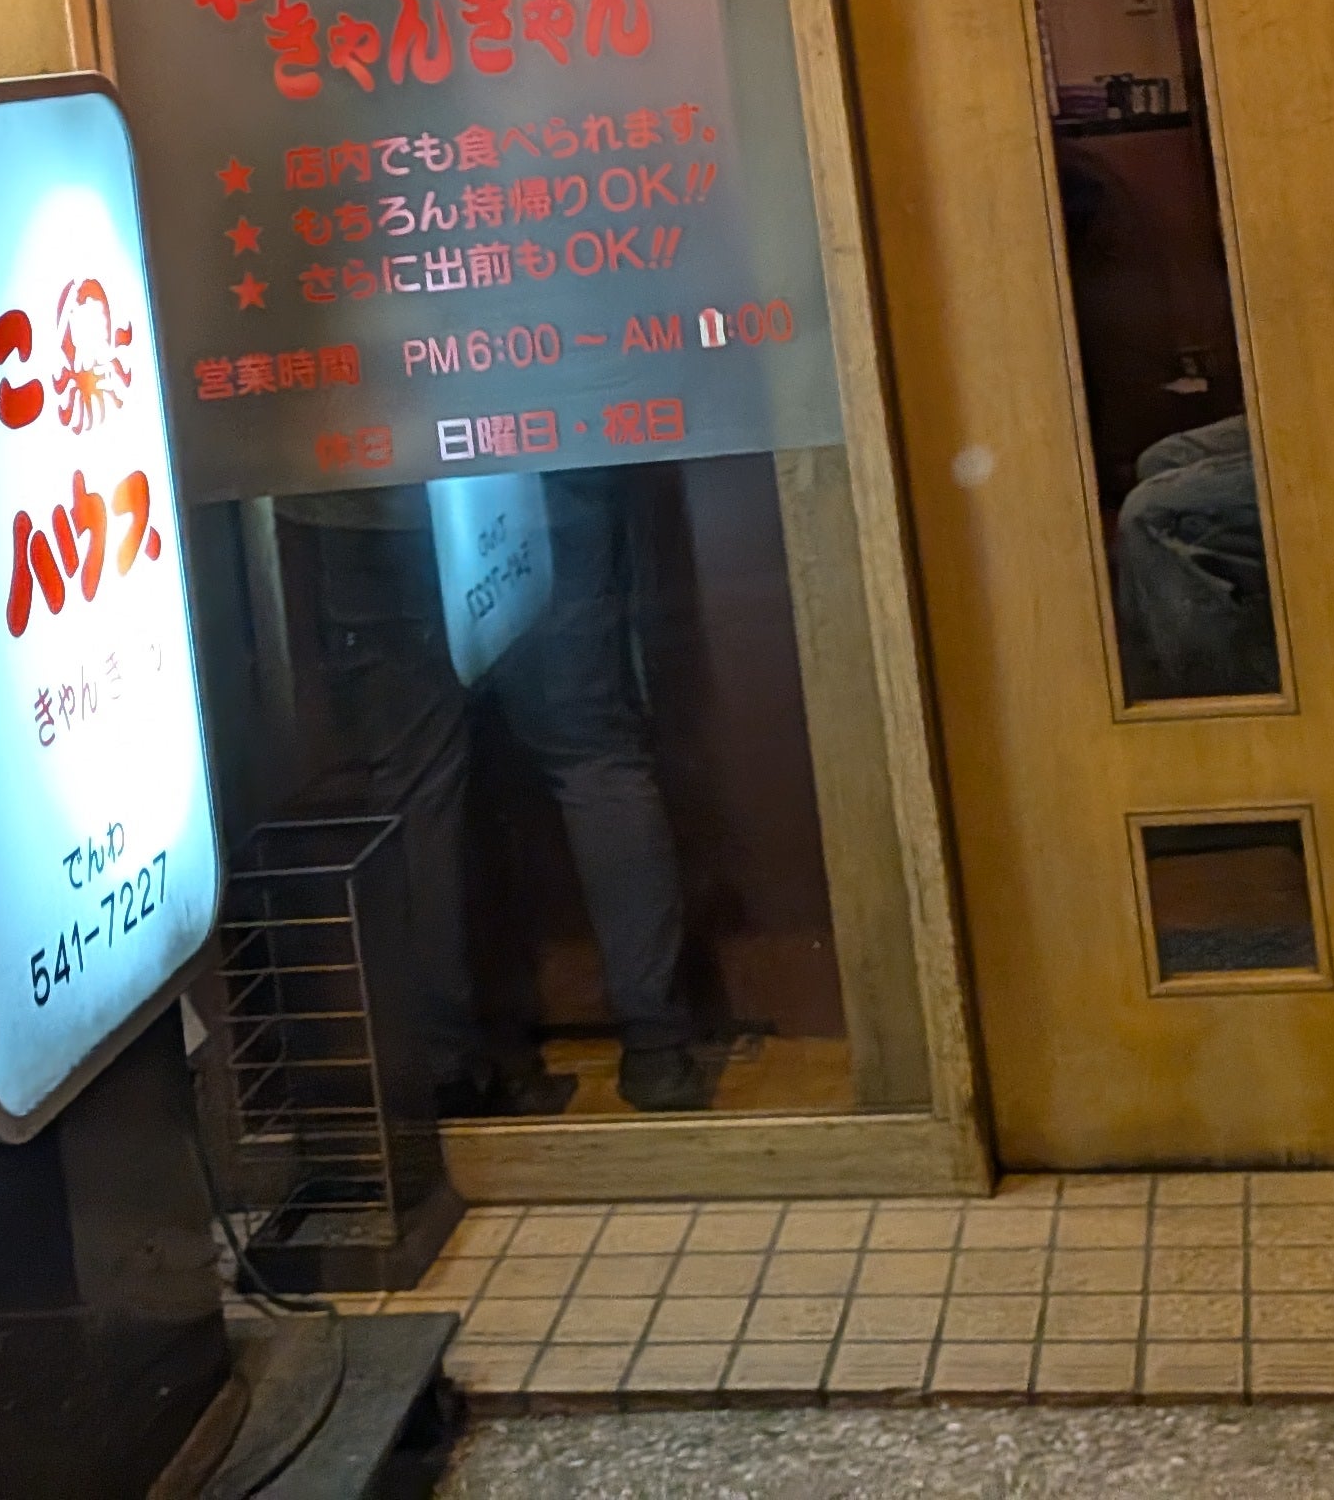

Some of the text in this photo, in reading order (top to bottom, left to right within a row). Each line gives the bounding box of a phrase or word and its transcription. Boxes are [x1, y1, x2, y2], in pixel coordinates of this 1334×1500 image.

[285, 102, 718, 190] 店内でも食べられます。
[194, 343, 360, 400] 営業時間
[622, 314, 683, 355] AM
[438, 397, 685, 462] 日曜日・祝日
[5, 467, 163, 639] ハウス
[63, 821, 125, 890] でんわ
[30, 850, 168, 1007] 541-7227
